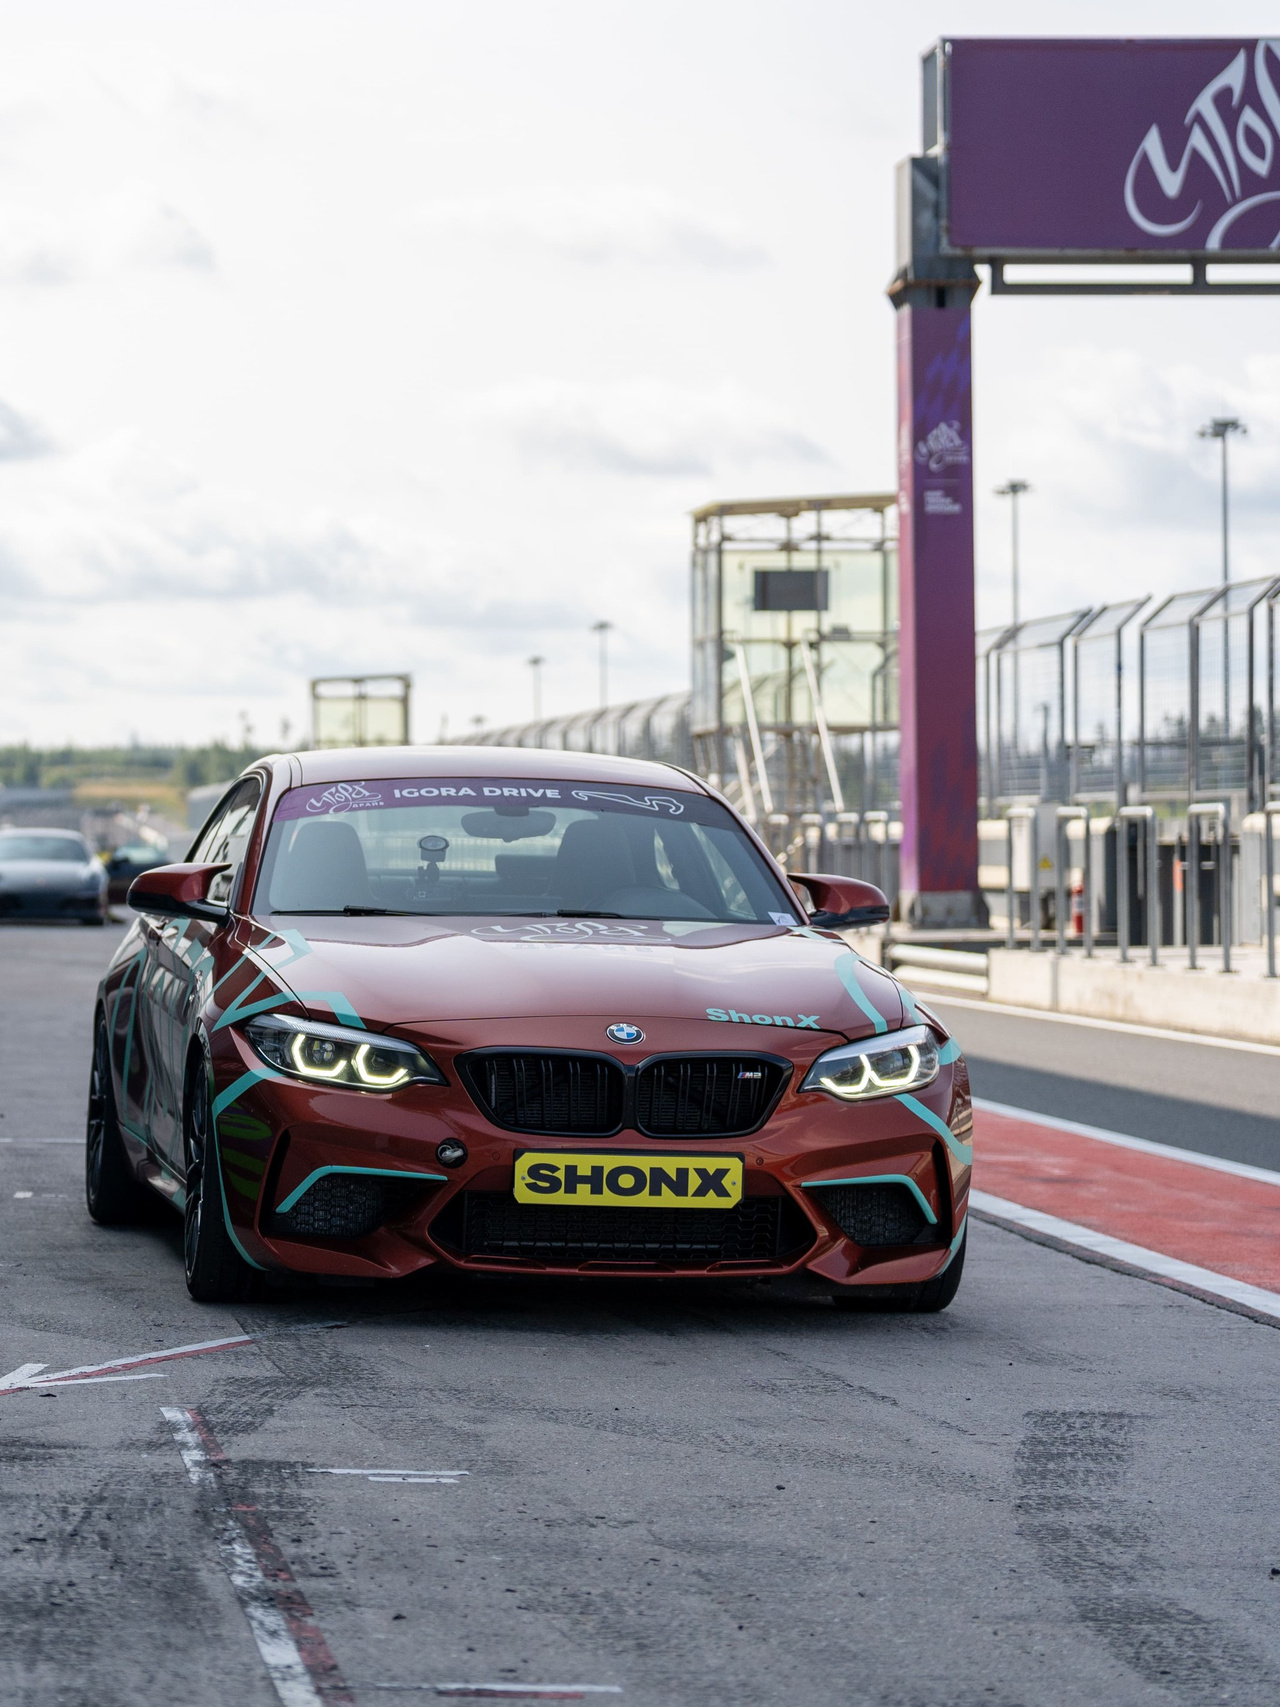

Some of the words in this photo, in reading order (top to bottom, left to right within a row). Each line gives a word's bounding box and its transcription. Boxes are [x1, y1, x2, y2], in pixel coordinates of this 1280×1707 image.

[393, 787, 477, 798] IGORA
[482, 787, 562, 799] DRIVE
[705, 1007, 820, 1029] ShonX
[524, 1162, 733, 1198] SHONX
